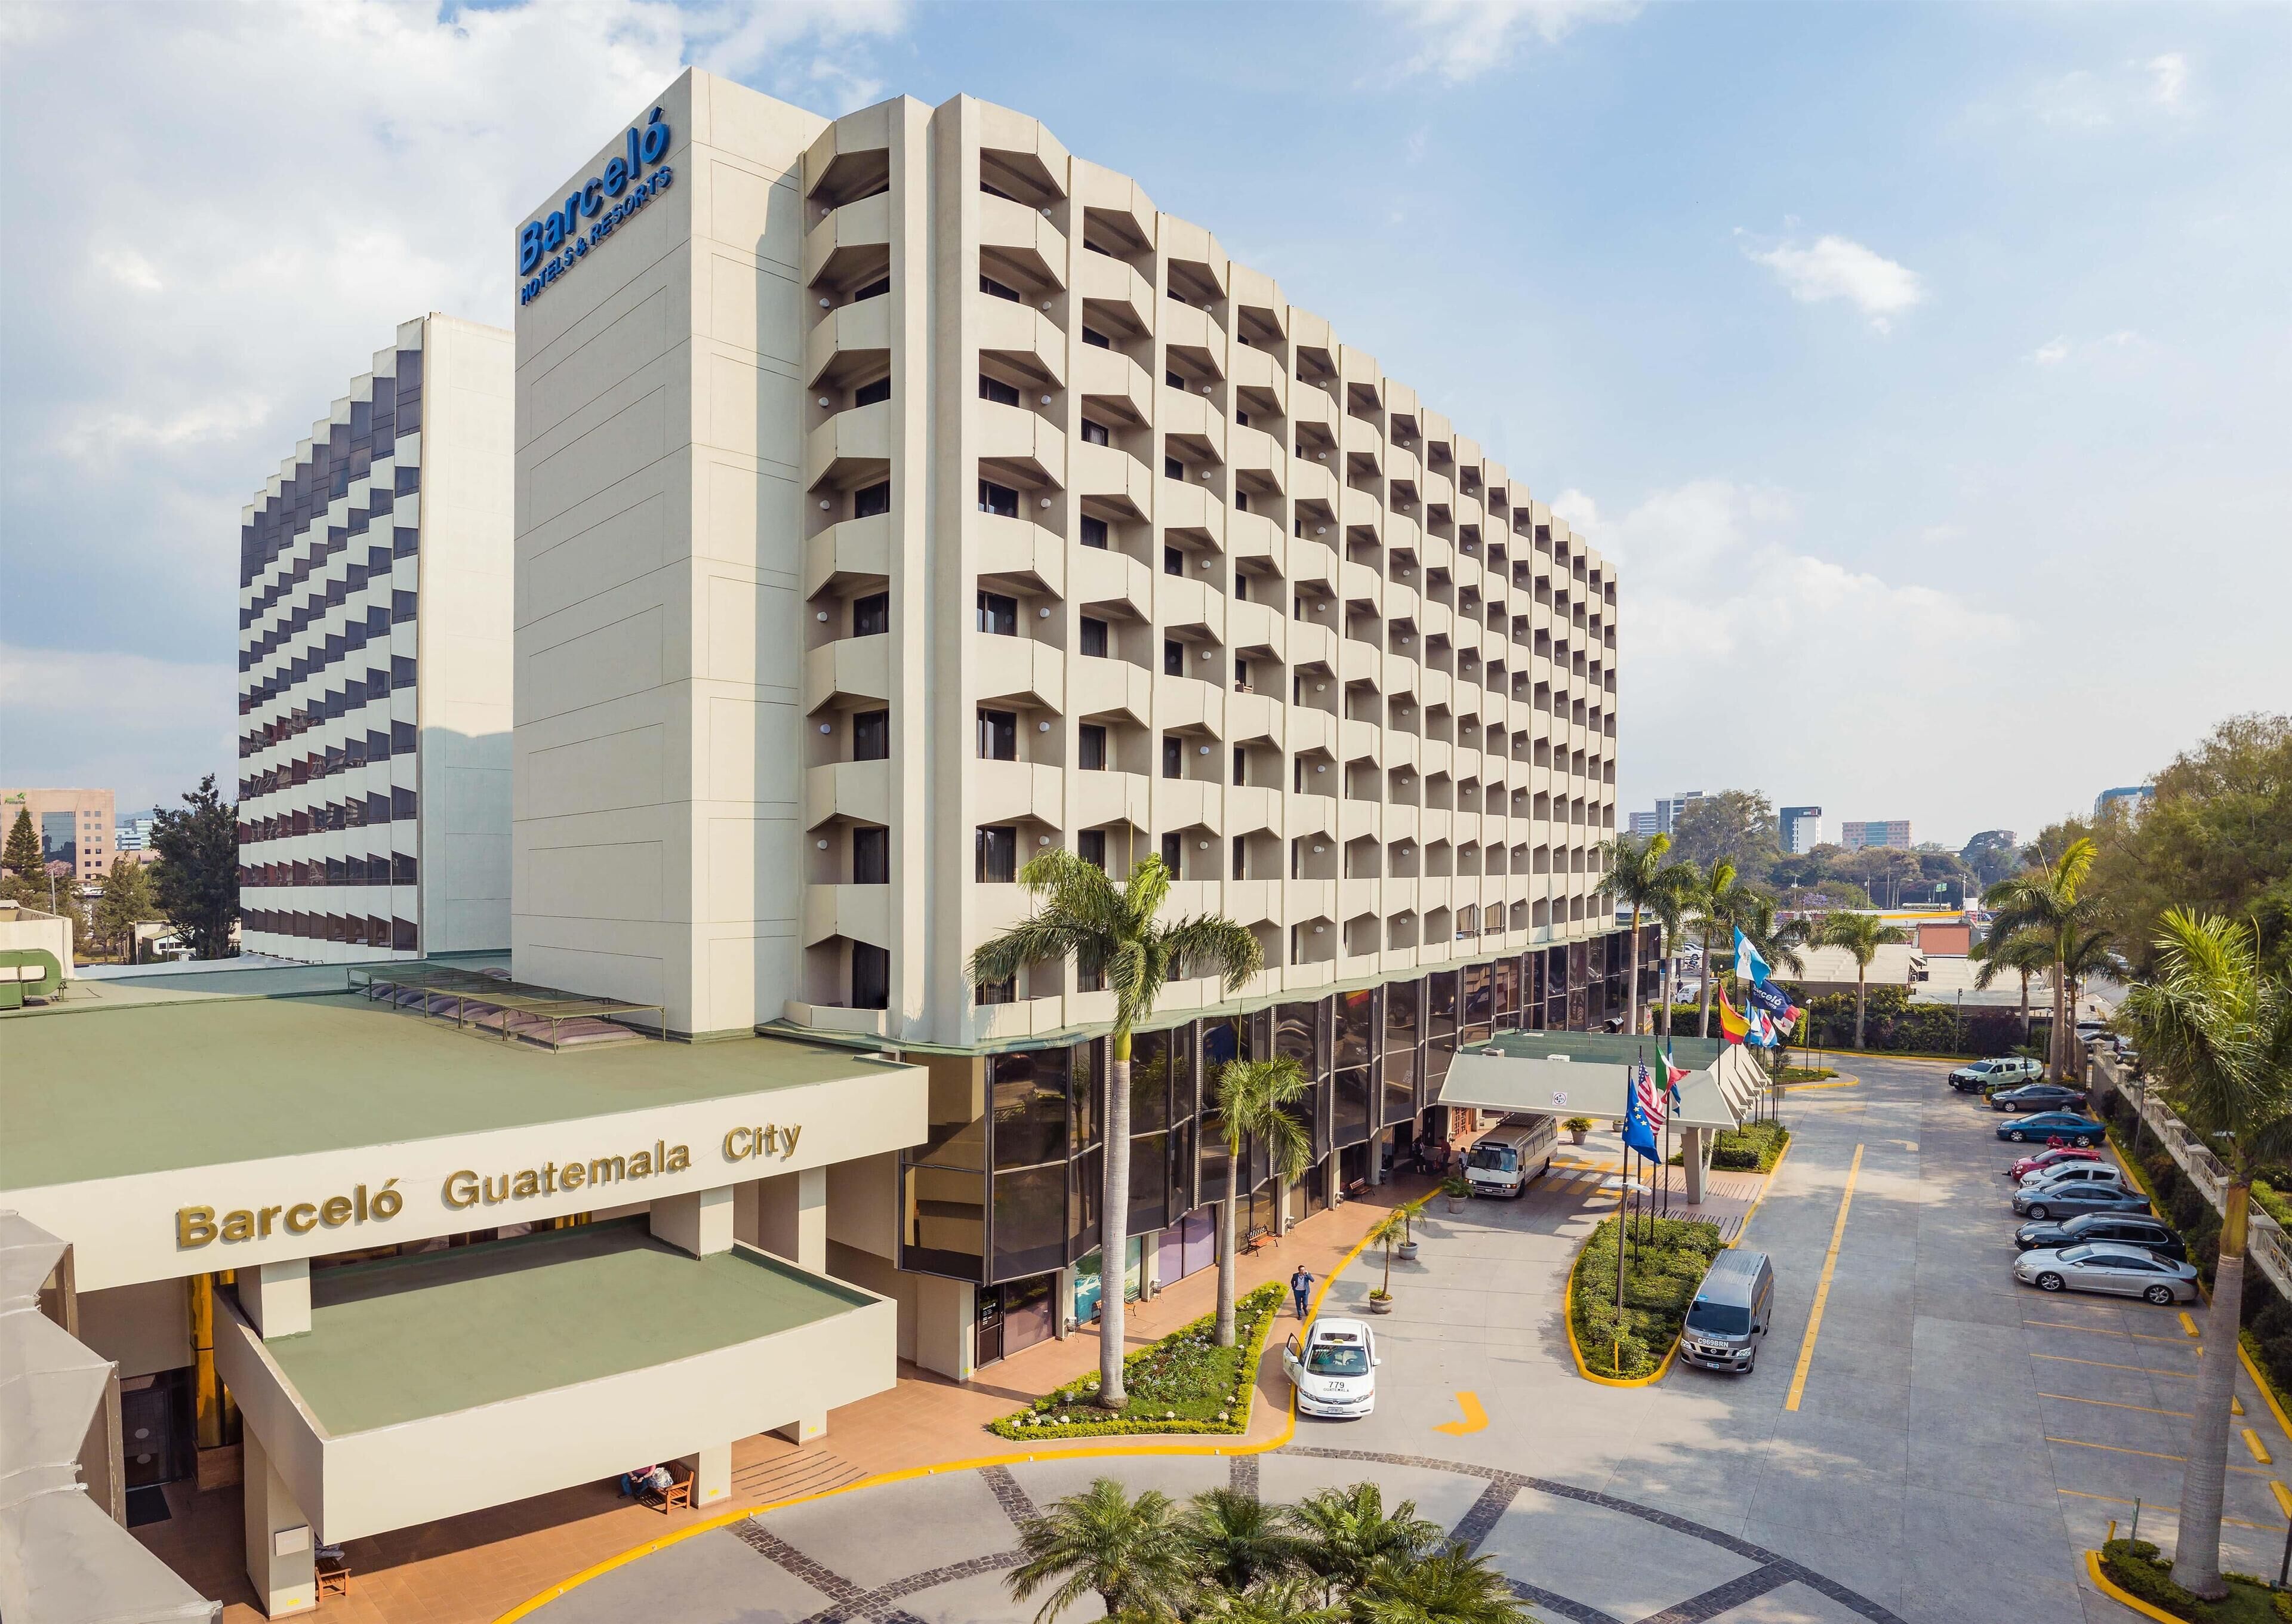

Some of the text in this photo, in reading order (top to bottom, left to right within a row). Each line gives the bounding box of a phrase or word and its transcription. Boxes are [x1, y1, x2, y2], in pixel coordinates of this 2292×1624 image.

[520, 106, 670, 276] Barceló
[521, 166, 671, 306] HOTELS & RESORTS
[178, 1122, 802, 1247] Barceló Guatemala City
[1698, 1338, 1729, 1348] C969BRN
